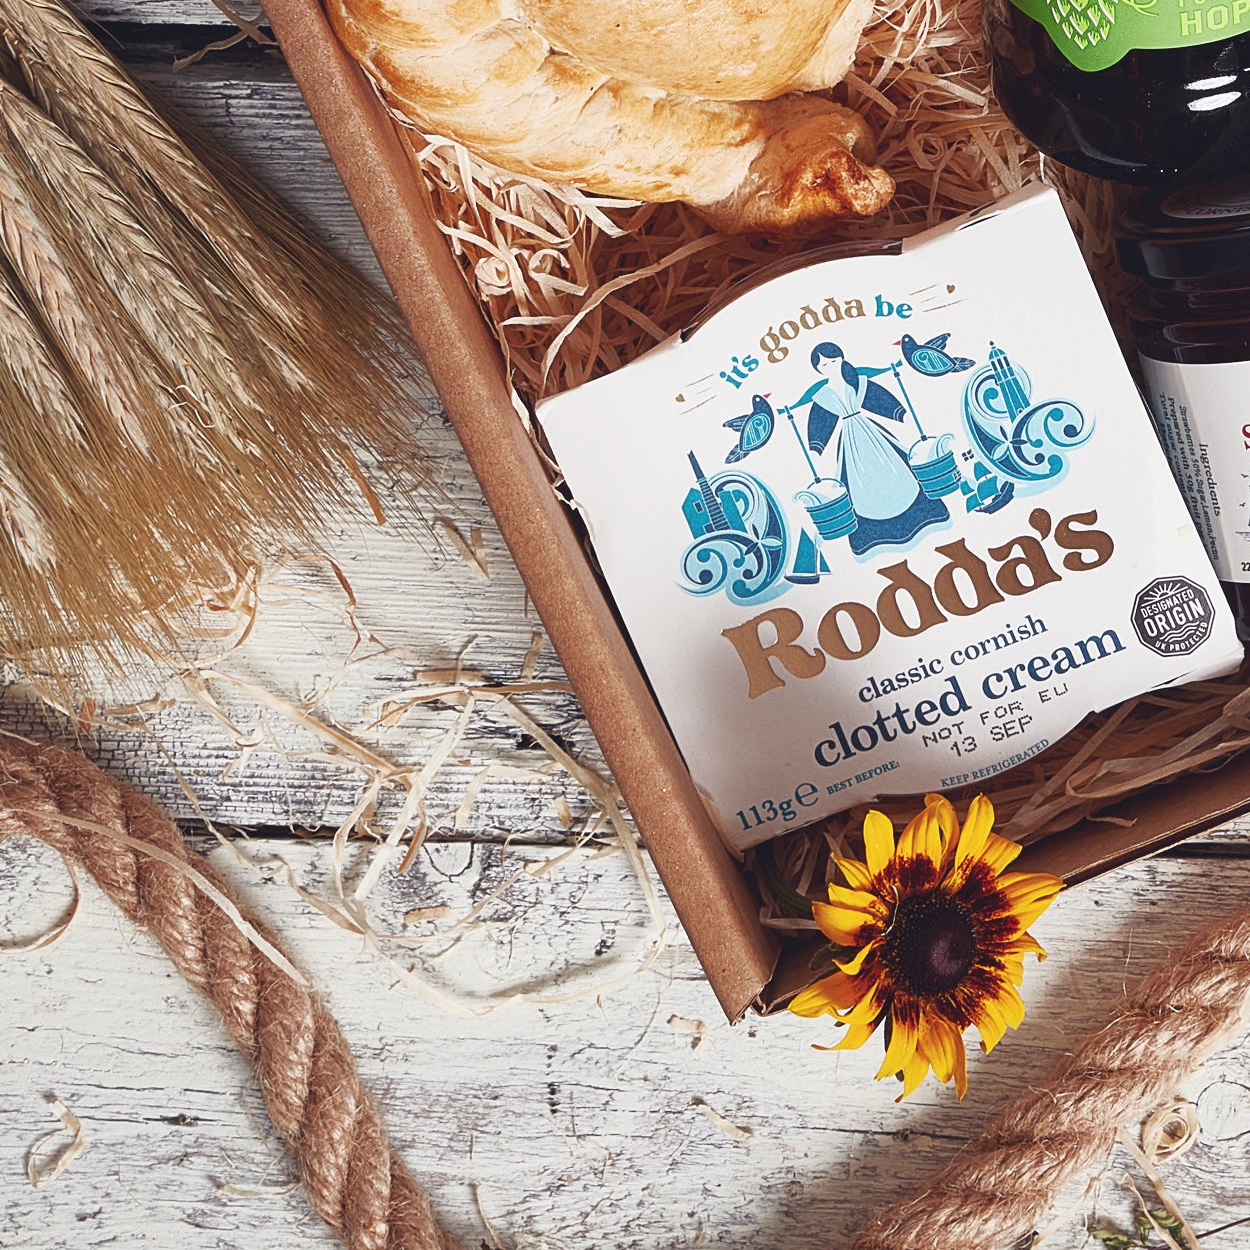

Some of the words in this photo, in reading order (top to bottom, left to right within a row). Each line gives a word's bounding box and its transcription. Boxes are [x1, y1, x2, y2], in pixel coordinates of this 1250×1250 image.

[719, 354, 760, 390] it's
[759, 297, 867, 364] godda
[874, 294, 913, 319] be
[1159, 393, 1169, 421] Total
[1167, 423, 1176, 451] sugar
[1174, 454, 1187, 495] content
[1168, 398, 1183, 444] Prepared
[1180, 445, 1189, 470] with
[1186, 472, 1194, 494] 50g
[1191, 495, 1201, 519] fruit
[1191, 459, 1201, 478] 50%
[1199, 444, 1221, 517] Ingredients
[720, 508, 1115, 700] Rodda's
[1141, 589, 1194, 618] DESIGNATED
[1144, 598, 1205, 637] ORIGIN
[857, 654, 944, 704] classic
[950, 614, 1048, 668] cornish
[1155, 641, 1167, 650] UK
[1169, 622, 1208, 652] PROTECTED
[813, 677, 972, 768] clotted
[981, 629, 1127, 700] cream
[922, 722, 965, 748] NOT
[979, 699, 1024, 725] FOR
[1038, 683, 1069, 704] EU
[940, 771, 969, 788] KEEP
[971, 738, 1050, 780] REFRIGERATED
[950, 736, 978, 758] 13
[990, 713, 1035, 743] SEP
[826, 779, 853, 796] BEST
[856, 760, 901, 784] BEFORE:
